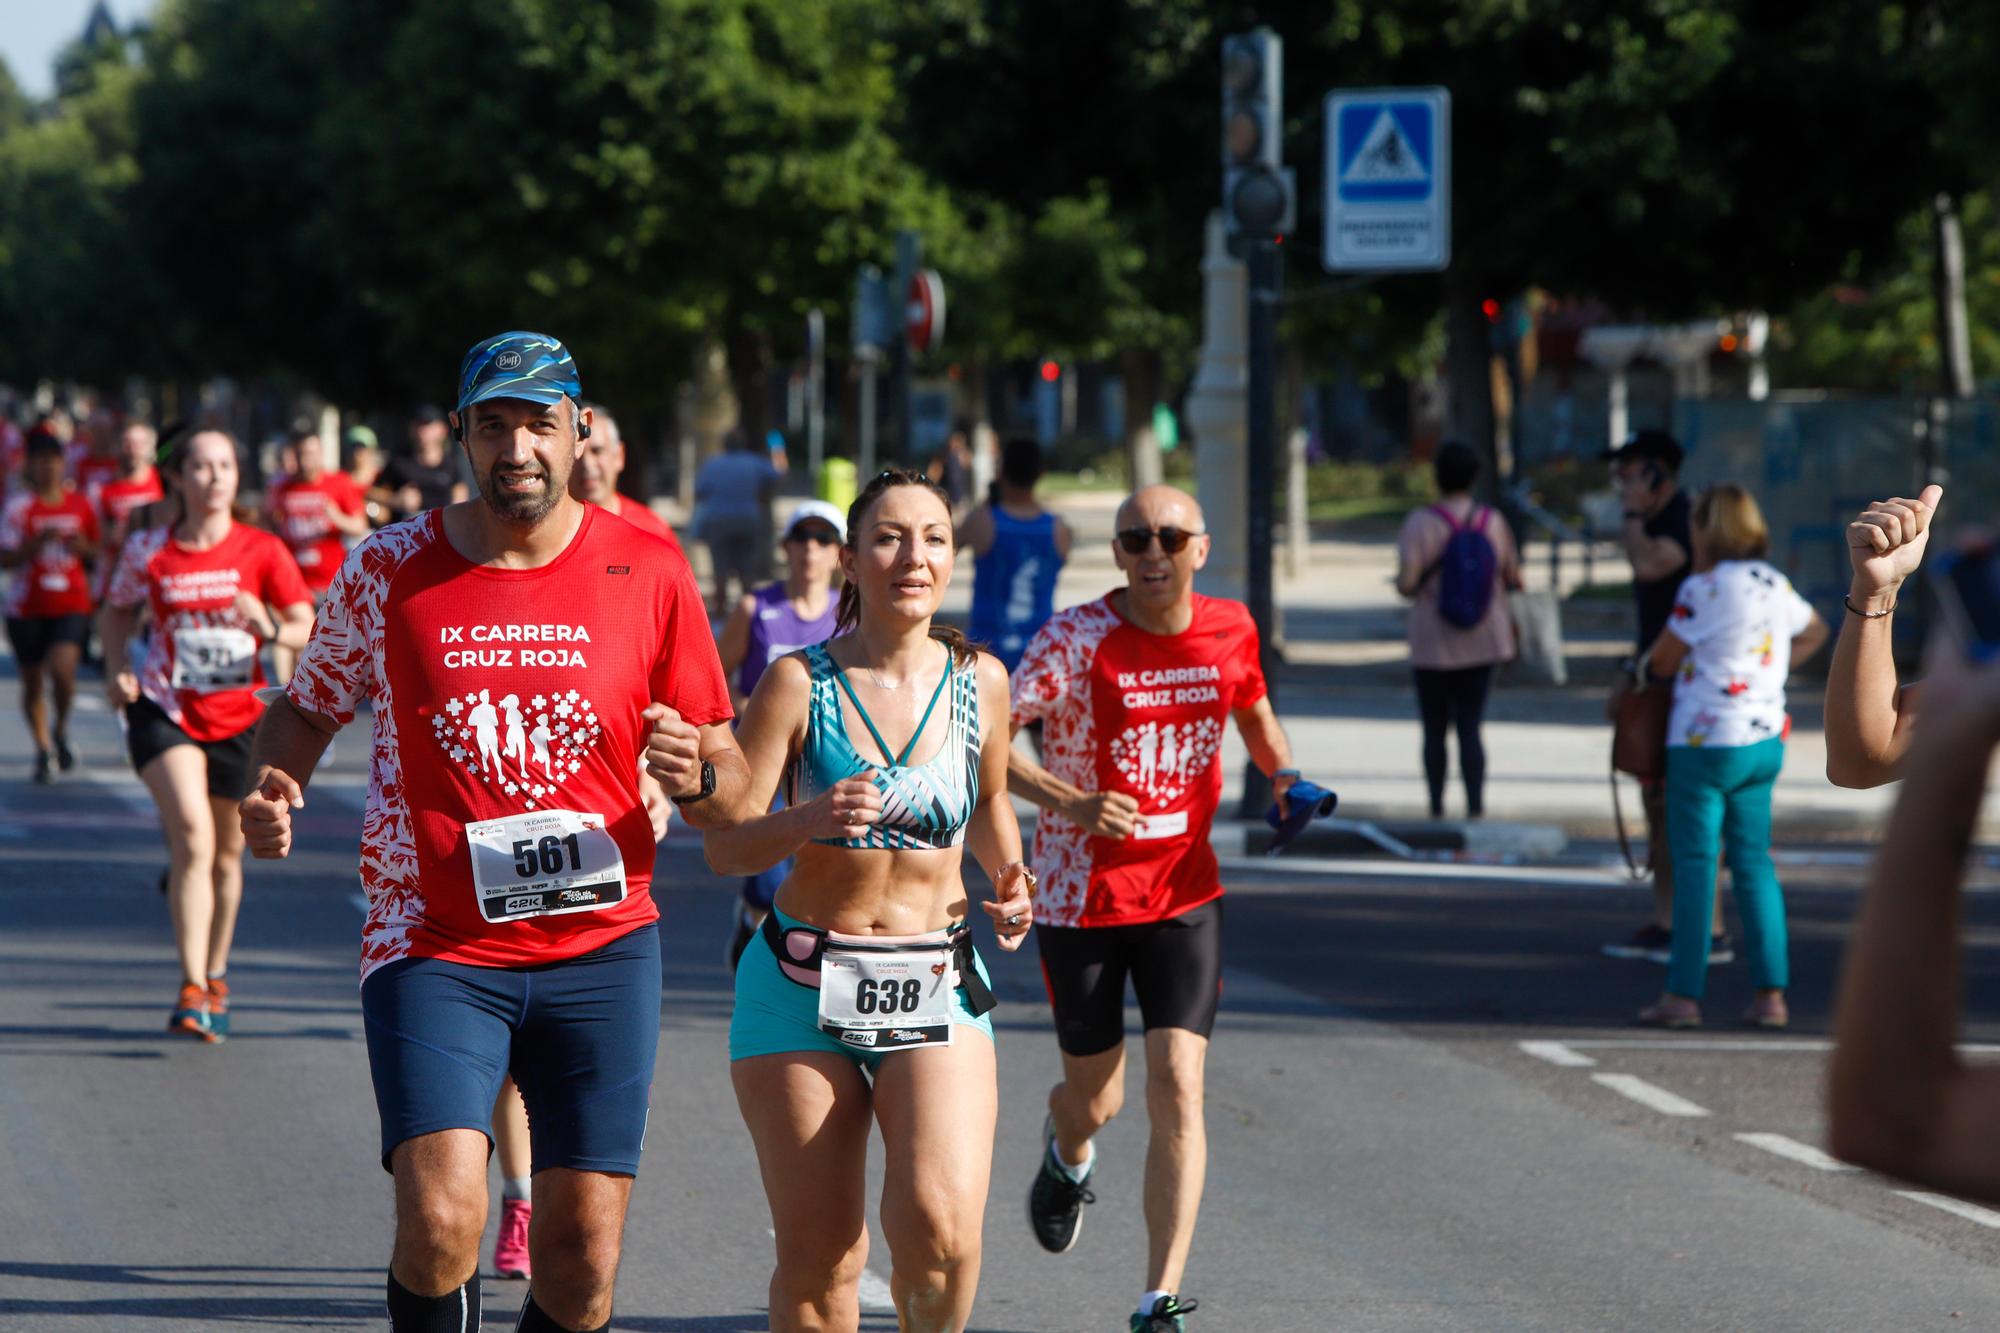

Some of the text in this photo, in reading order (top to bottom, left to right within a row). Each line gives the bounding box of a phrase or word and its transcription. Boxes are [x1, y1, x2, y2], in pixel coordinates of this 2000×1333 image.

[500, 355, 518, 366] Buff
[441, 624, 591, 643] IX CARRERA
[443, 649, 587, 668] CRUZ ROJA
[1118, 665, 1220, 688] IX CARRERA
[1123, 686, 1219, 709] CRUZ ROJA
[526, 823, 561, 833] CRUZ ROJA
[532, 816, 561, 826] CARRERA
[512, 833, 582, 878] 561
[508, 897, 539, 909] 42K
[570, 893, 597, 902] CORRER
[856, 979, 921, 1014] 638
[843, 1033, 874, 1043] 42K
